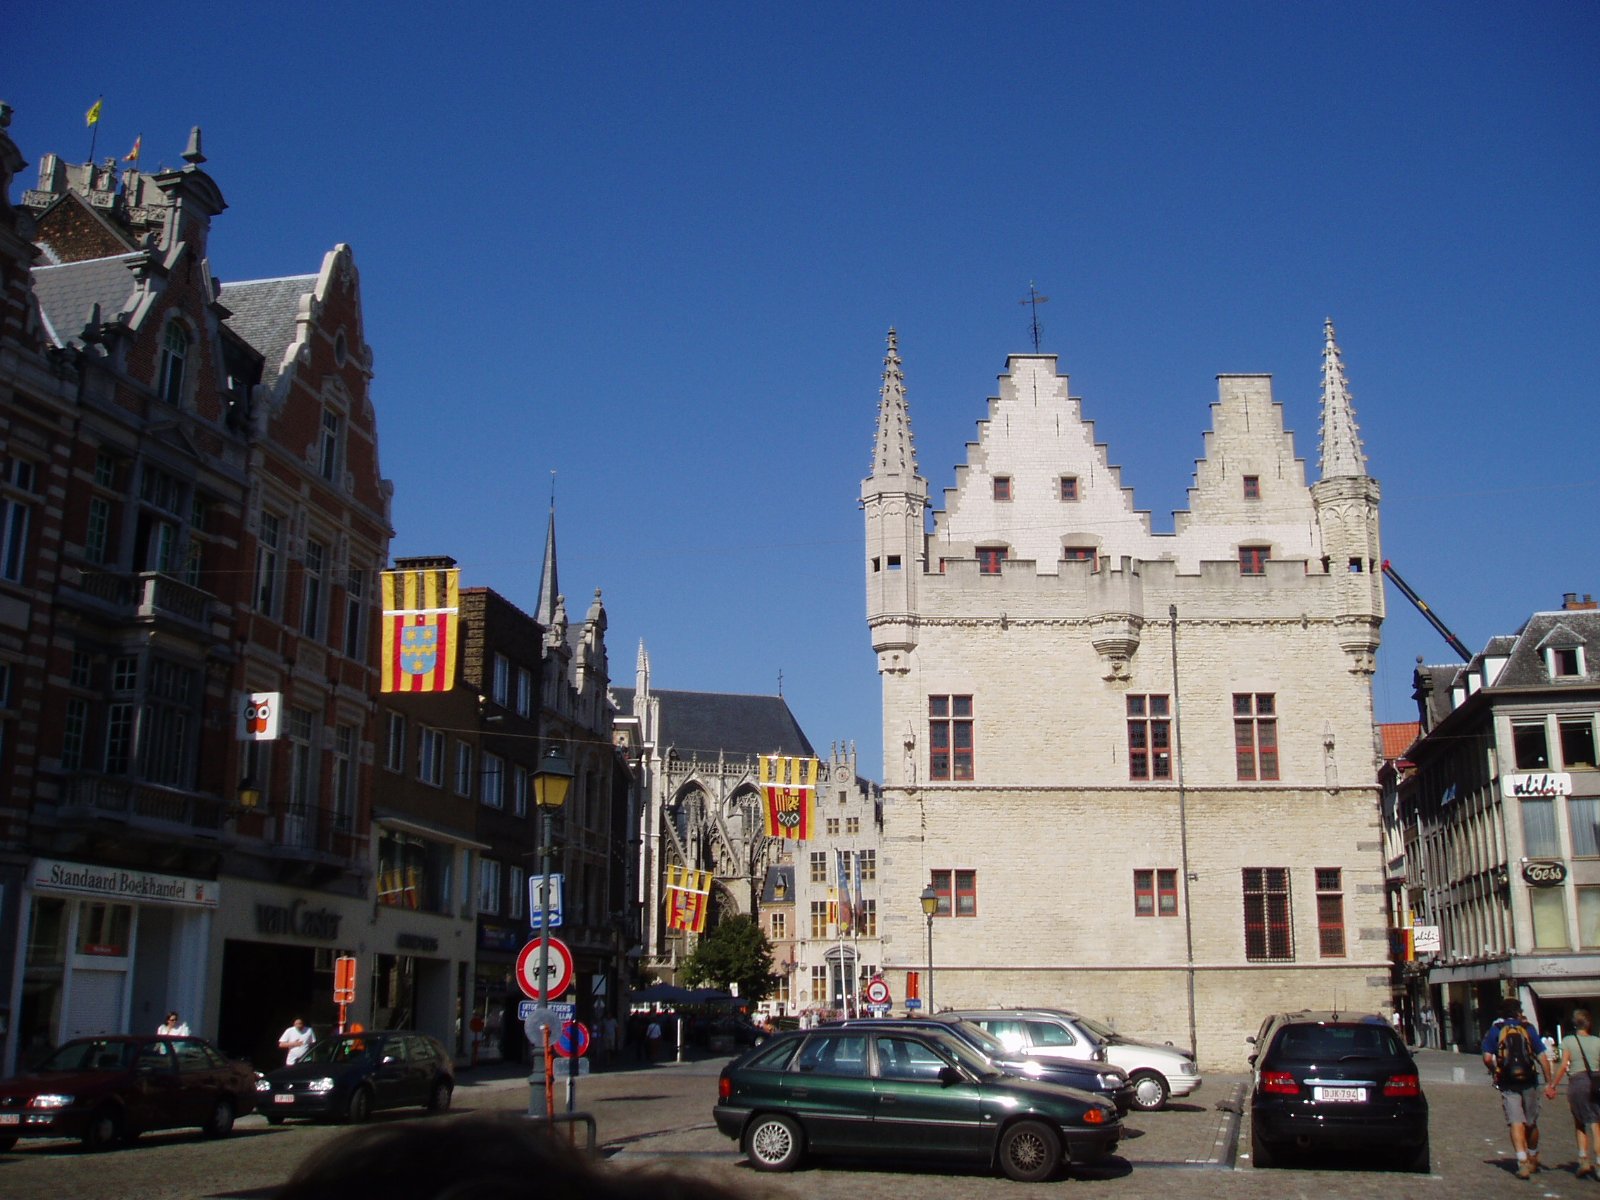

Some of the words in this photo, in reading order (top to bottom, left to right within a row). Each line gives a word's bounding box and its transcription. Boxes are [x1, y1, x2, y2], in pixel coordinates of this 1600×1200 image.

[51, 864, 116, 890] Standaard
[119, 873, 186, 898] Boekhandel
[1526, 864, 1562, 881] Tess
